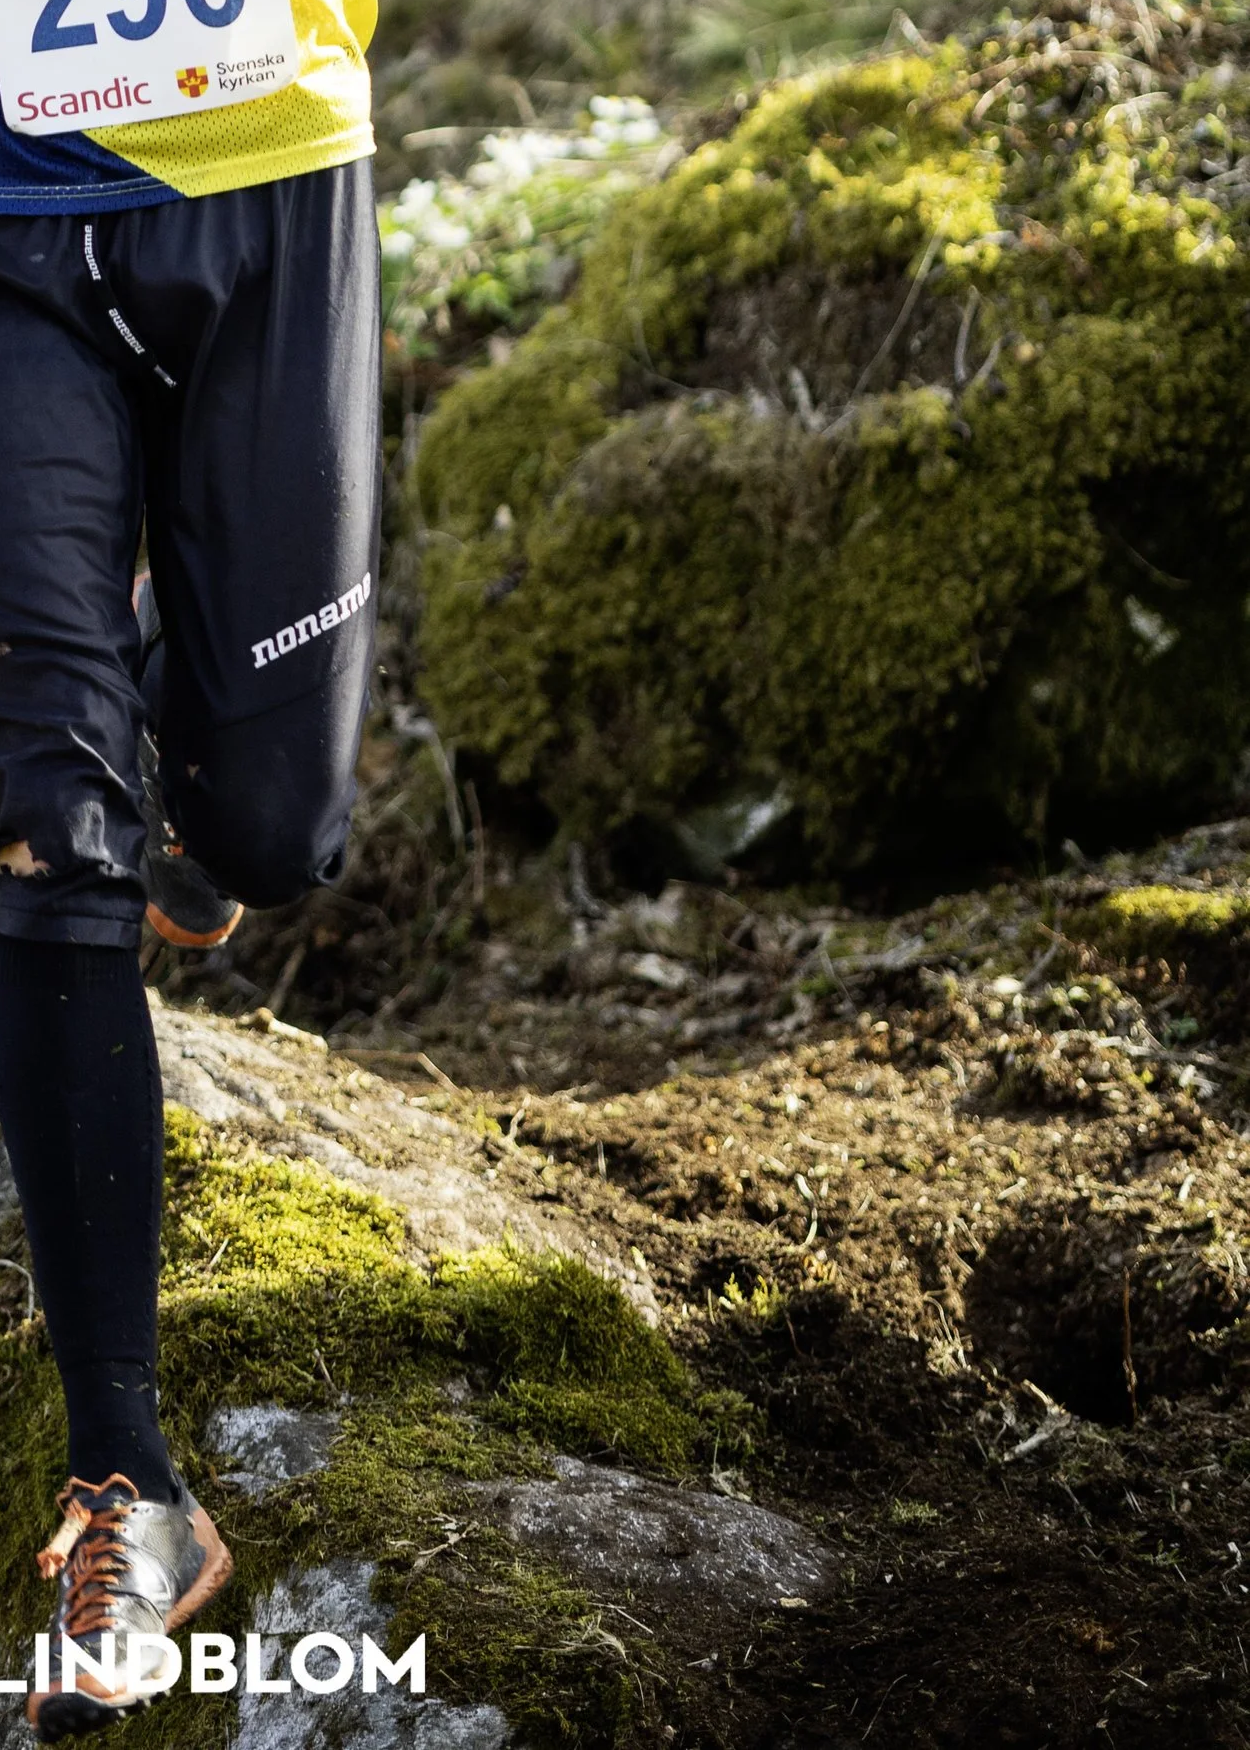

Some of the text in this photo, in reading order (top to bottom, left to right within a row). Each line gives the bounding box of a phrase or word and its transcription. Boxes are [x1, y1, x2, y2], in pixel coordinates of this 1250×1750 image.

[216, 52, 285, 76] Svenska
[218, 68, 276, 91] kyrkan
[17, 76, 152, 122] Scandic
[84, 224, 102, 281] noname
[108, 307, 146, 355] noname
